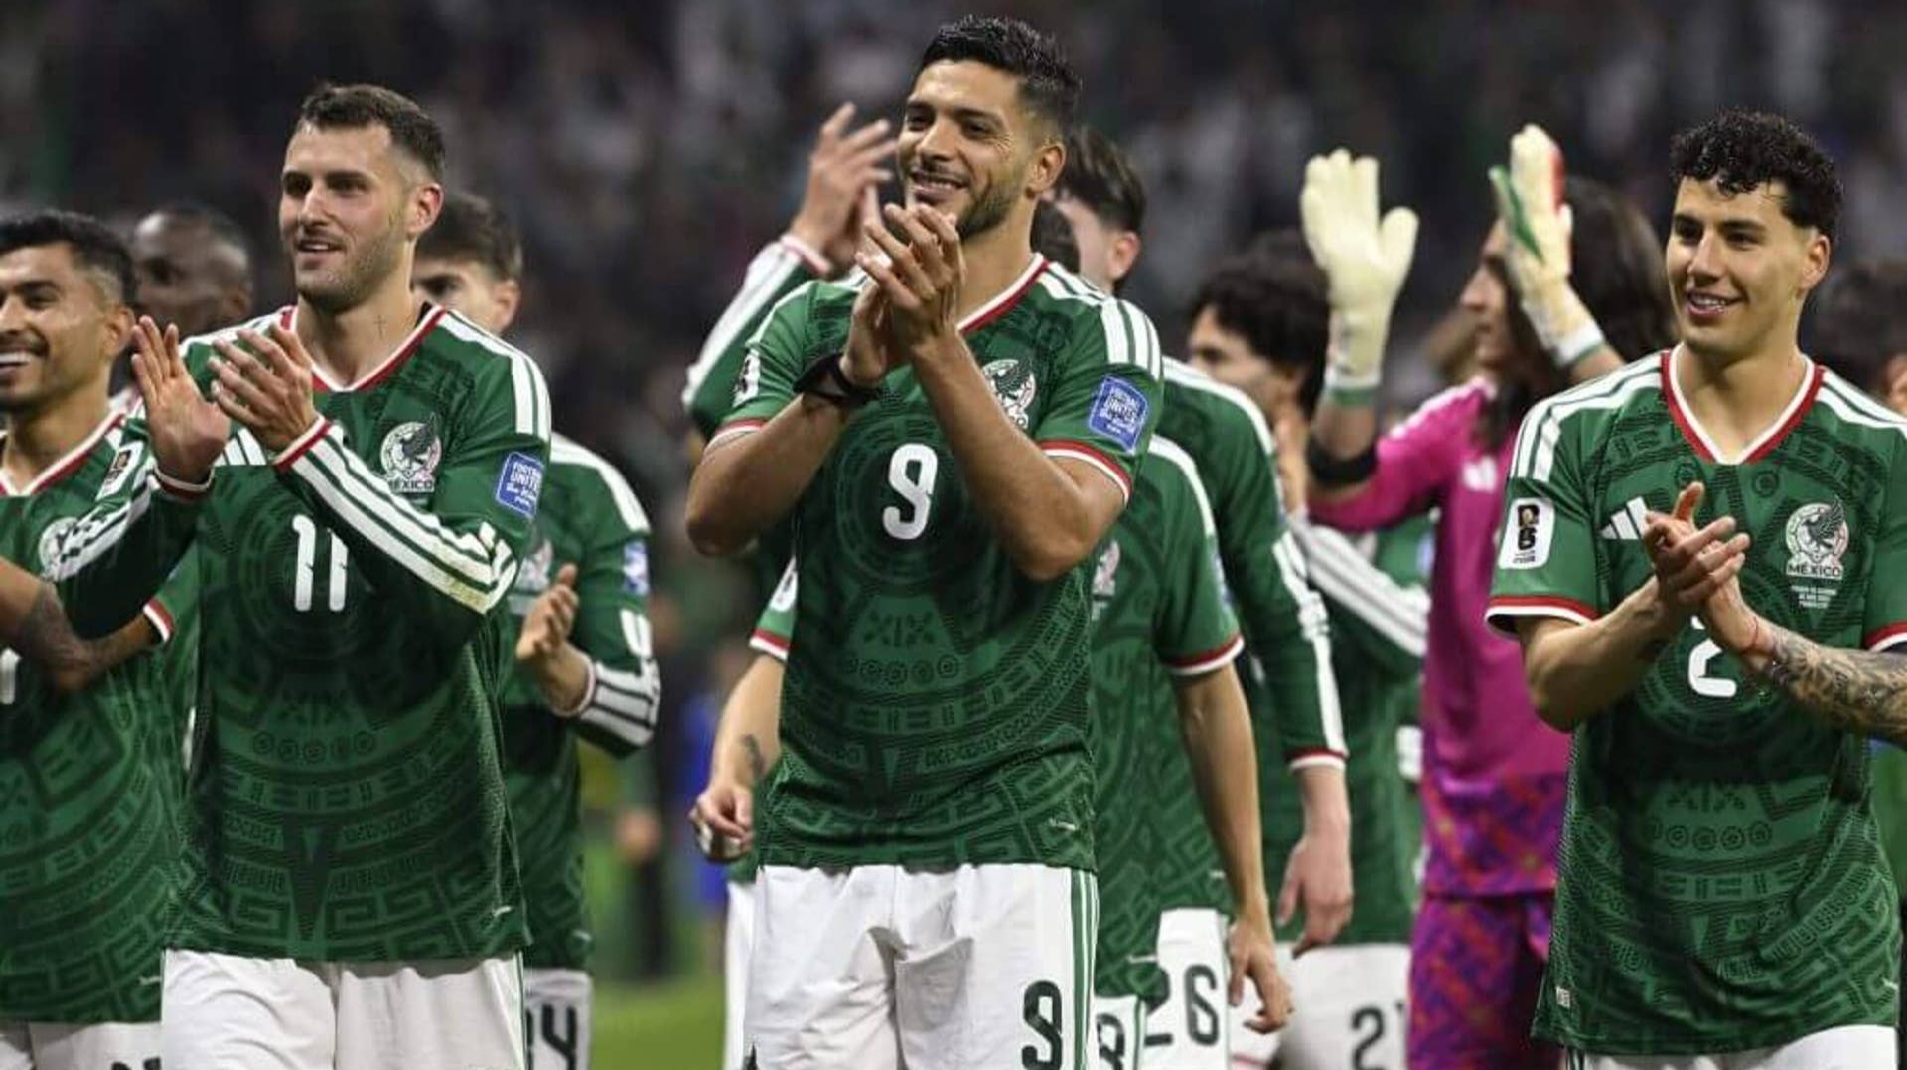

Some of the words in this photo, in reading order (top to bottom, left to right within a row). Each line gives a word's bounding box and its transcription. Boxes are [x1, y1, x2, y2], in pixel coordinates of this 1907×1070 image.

[882, 443, 938, 540] 9
[292, 514, 348, 611] 11
[1688, 615, 1737, 697] 2
[1022, 980, 1063, 1070] 9
[1352, 999, 1405, 1070] 2
